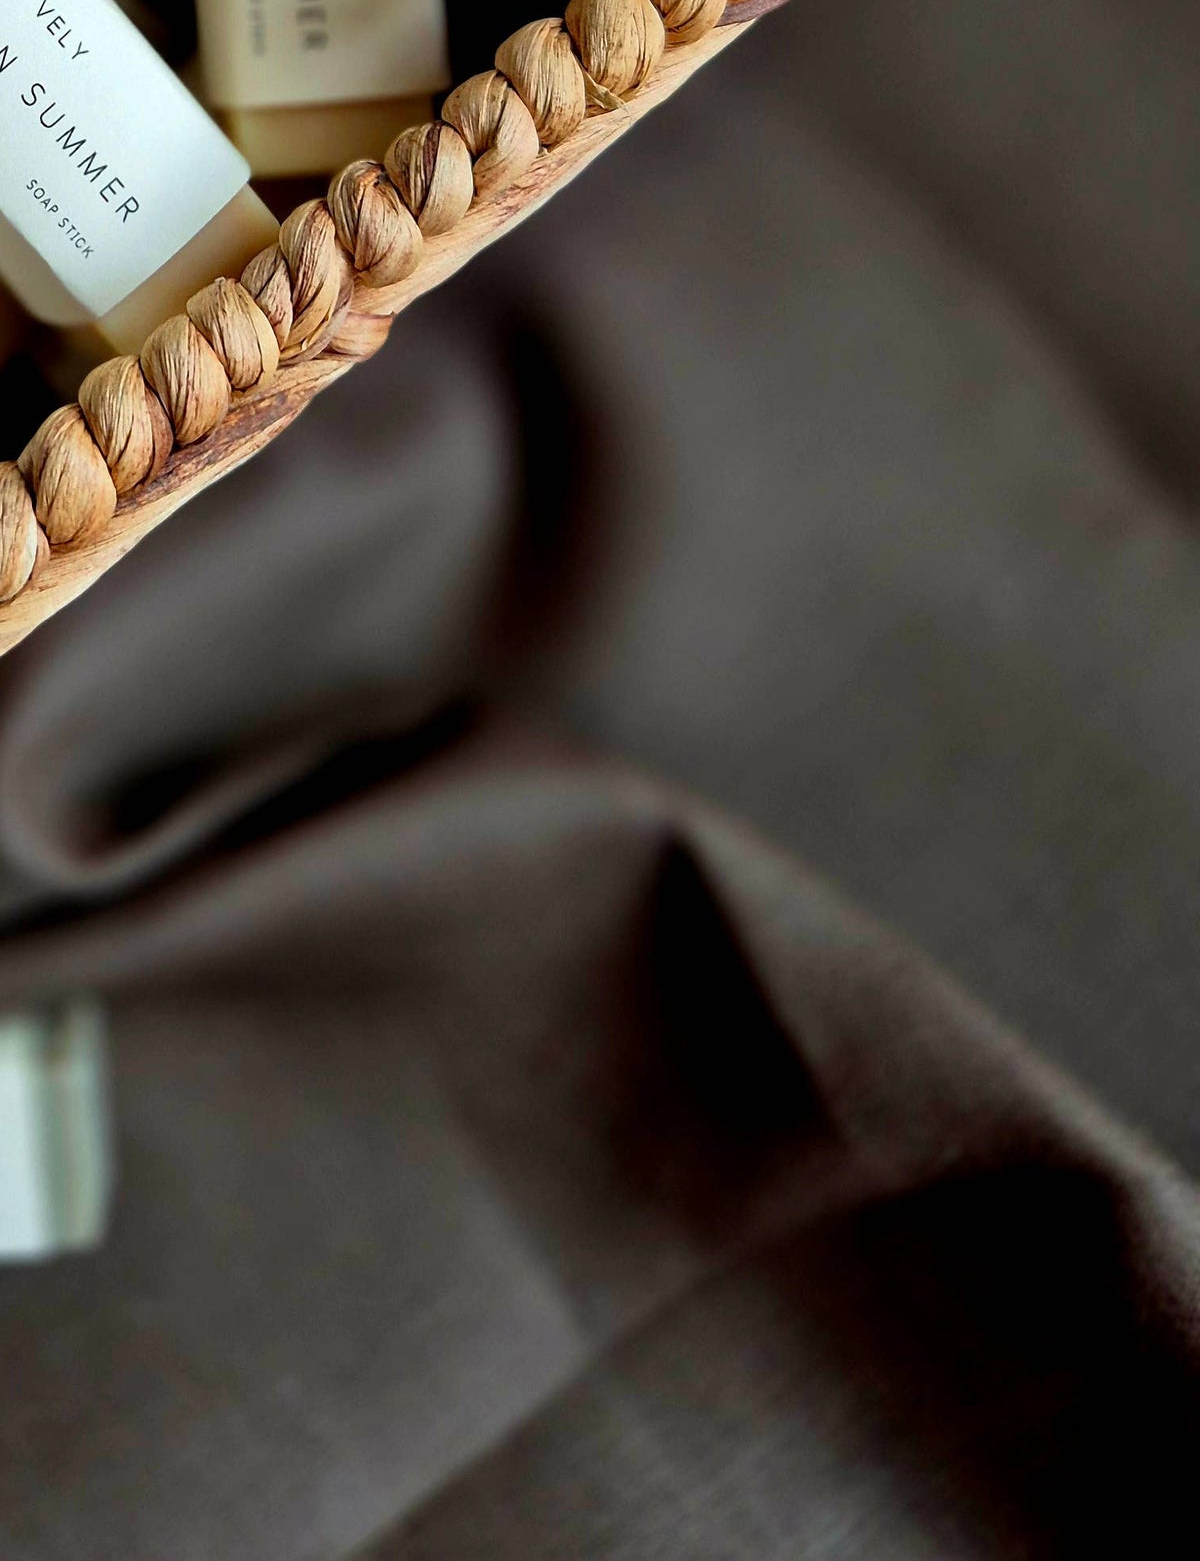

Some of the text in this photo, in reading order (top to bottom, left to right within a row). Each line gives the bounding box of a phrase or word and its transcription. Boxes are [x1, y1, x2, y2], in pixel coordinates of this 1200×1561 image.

[36, 0, 89, 59] VELY
[21, 83, 139, 223] SUMMER
[26, 179, 94, 259] SOAP STICK
